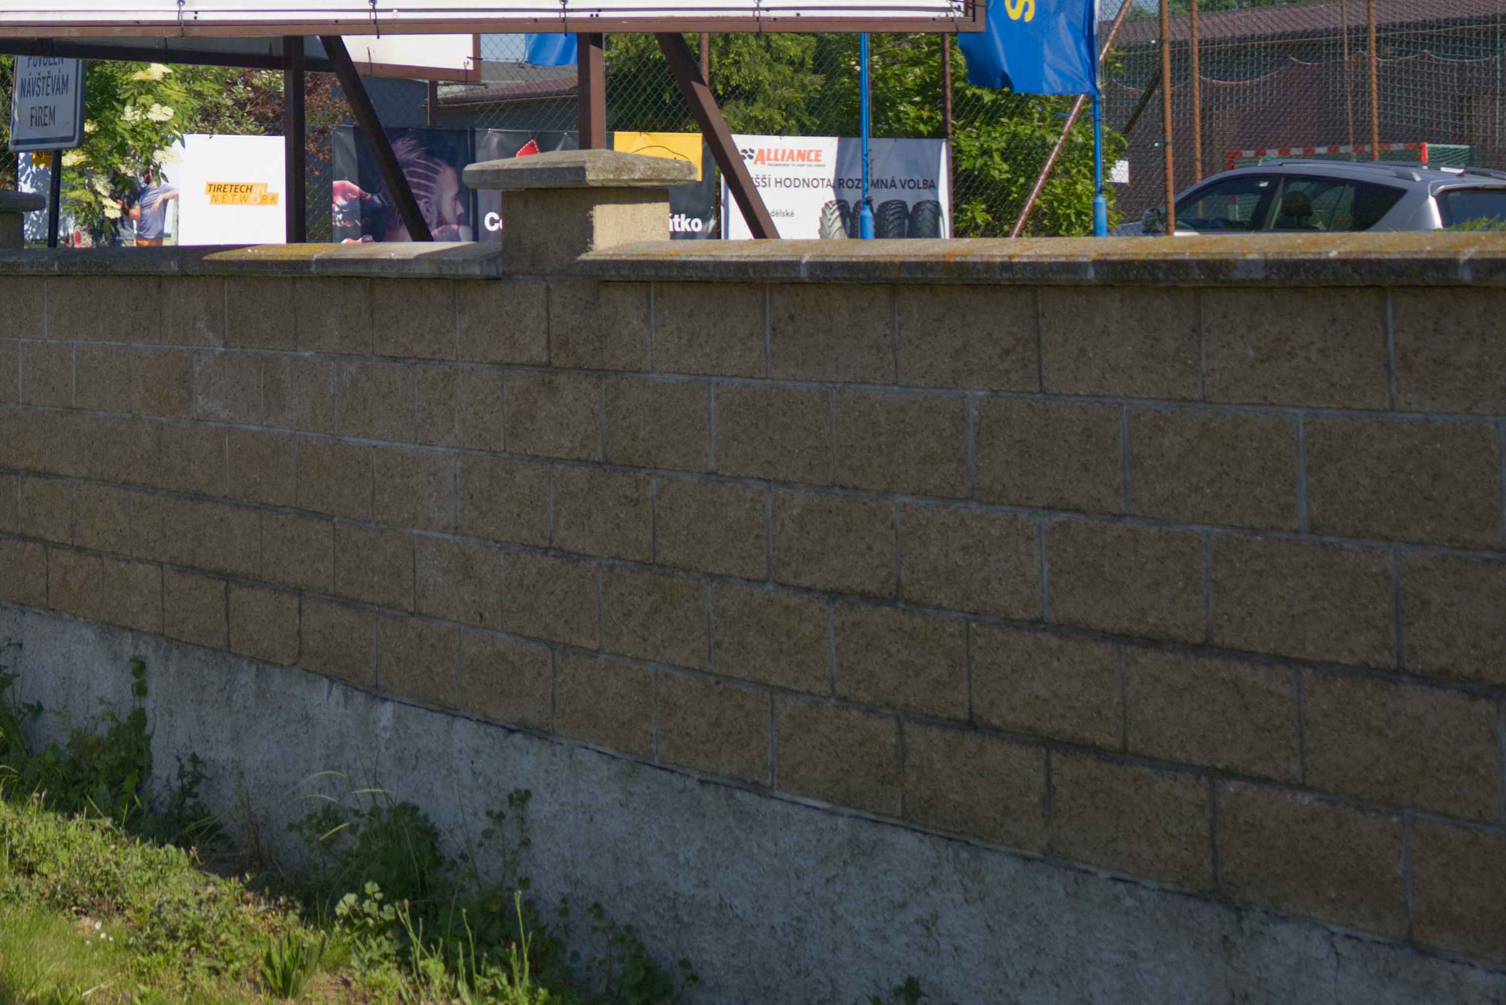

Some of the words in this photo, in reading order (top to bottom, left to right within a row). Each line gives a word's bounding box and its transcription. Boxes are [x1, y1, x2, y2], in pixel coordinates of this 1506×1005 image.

[20, 69, 69, 98] NÁVŠTĚVÁM
[30, 105, 56, 127] FIREM
[753, 148, 822, 164] ALLIANCE
[207, 183, 253, 194] TIRETECH
[838, 176, 897, 189] ROZMNÁ
[900, 179, 937, 190] VOLBA
[211, 193, 277, 204] NETWORK
